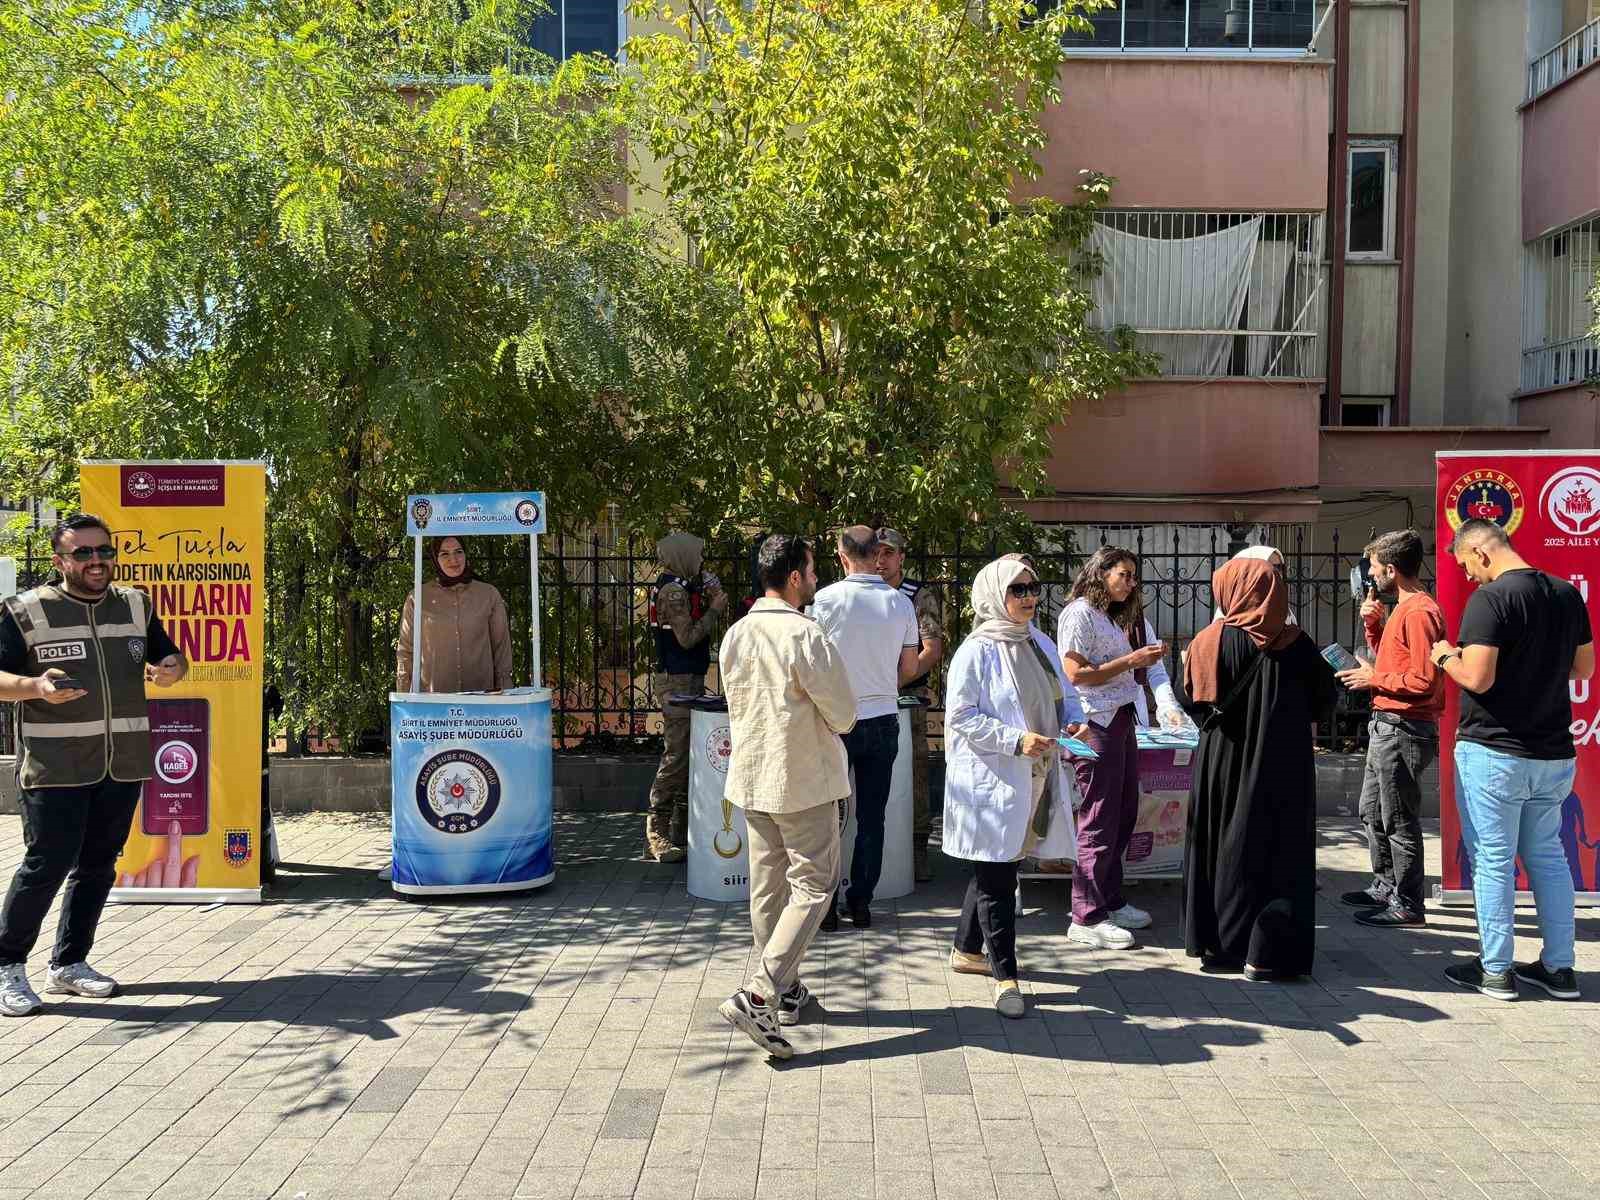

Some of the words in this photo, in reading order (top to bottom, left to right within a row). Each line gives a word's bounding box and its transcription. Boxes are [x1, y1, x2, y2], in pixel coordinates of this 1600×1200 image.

[1450, 471, 1520, 501] JANDARMA
[111, 529, 155, 562] Tek
[158, 527, 246, 562] Tuşla
[1544, 538, 1565, 546] 2025
[1567, 537, 1591, 546] AİLE
[112, 563, 163, 581] DDETİN
[167, 562, 252, 582] KARŞISINDA
[133, 584, 251, 616] INLARIN
[40, 645, 81, 658] POLİS
[427, 718, 463, 727] EMNİYET
[465, 716, 518, 727] MÜDÜRLÜĞÜ
[399, 729, 427, 742] ASAYİŞ
[430, 730, 455, 742] ŞUBE
[458, 727, 523, 740] MÜDÜRLÜĞÜ
